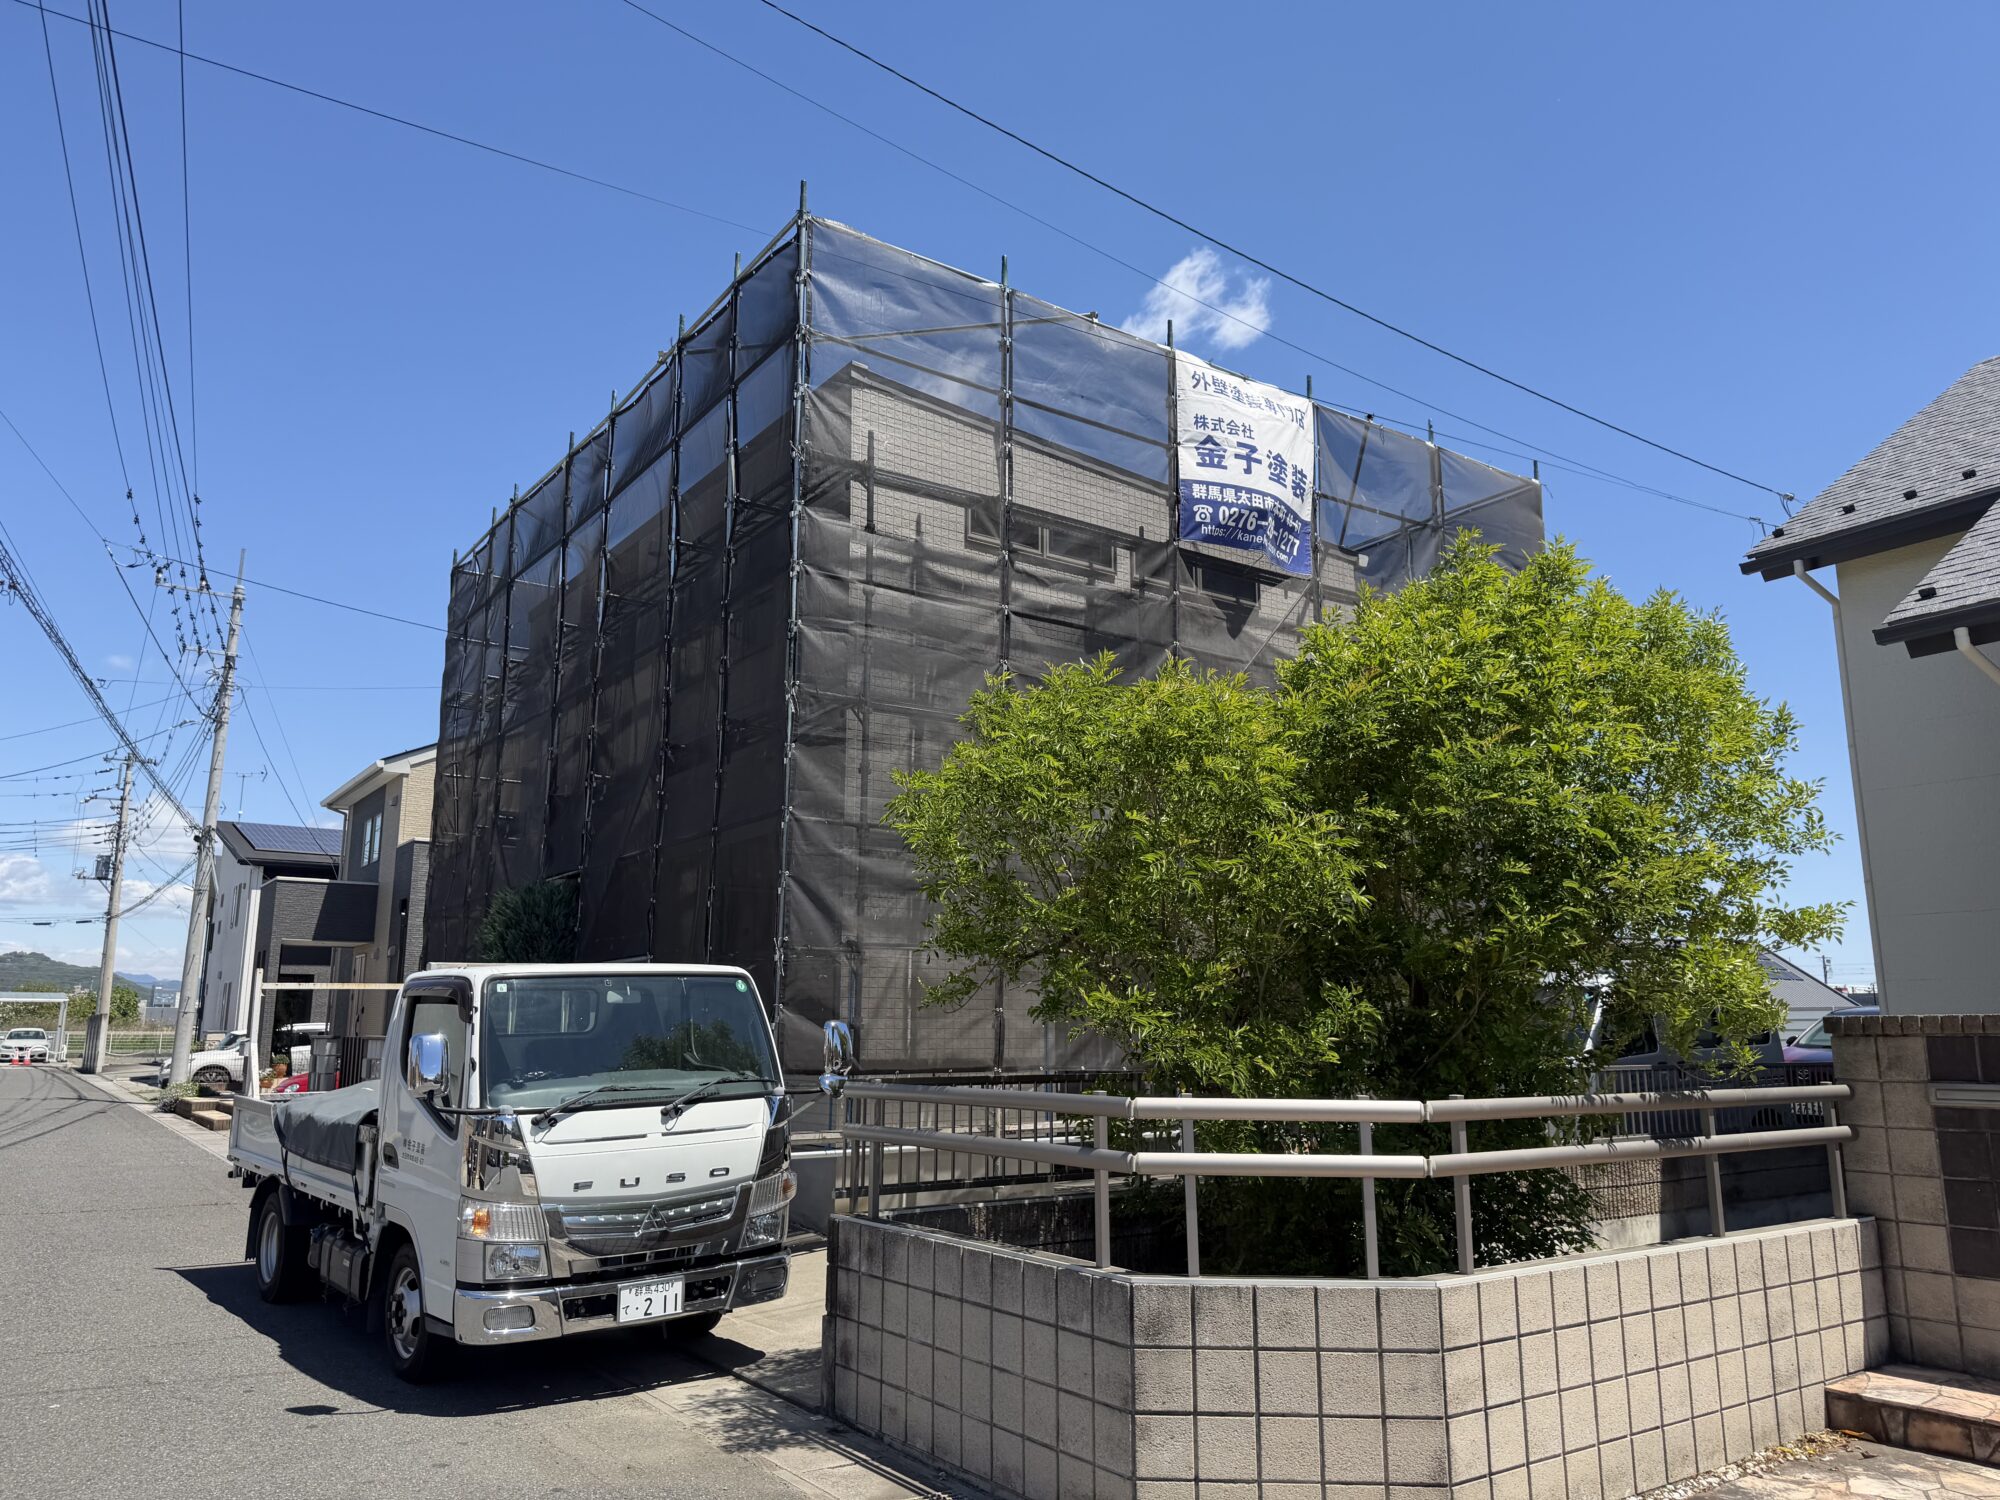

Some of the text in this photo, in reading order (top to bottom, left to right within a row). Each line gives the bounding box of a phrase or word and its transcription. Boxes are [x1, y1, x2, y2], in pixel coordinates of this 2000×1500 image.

[1191, 371, 1306, 431] 外壁塗装専門店
[1193, 413, 1256, 440] 株式会社
[1194, 434, 1308, 504] 金子塗装
[573, 1167, 730, 1193] FUSO
